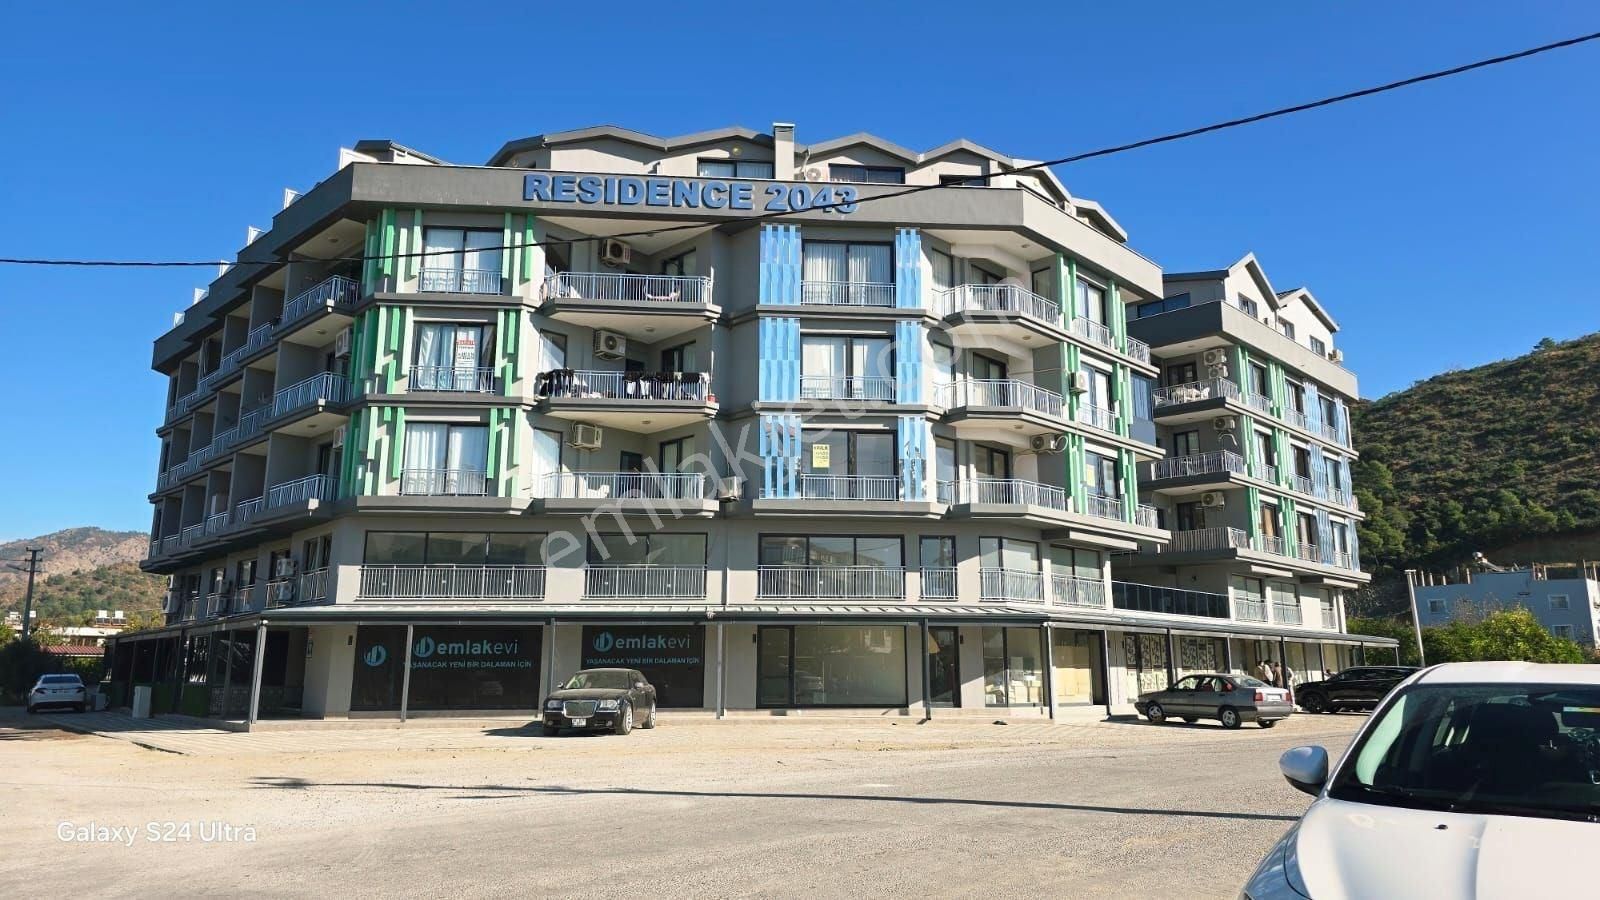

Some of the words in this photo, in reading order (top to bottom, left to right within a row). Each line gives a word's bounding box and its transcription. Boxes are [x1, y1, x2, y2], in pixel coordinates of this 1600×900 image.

[523, 173, 755, 210] RESIDENCE
[764, 183, 859, 214] 2043
[437, 639, 519, 655] emlakevi
[615, 634, 691, 649] emlakevi
[403, 660, 448, 670] ŞANACAK
[480, 660, 516, 669] DALAMAN
